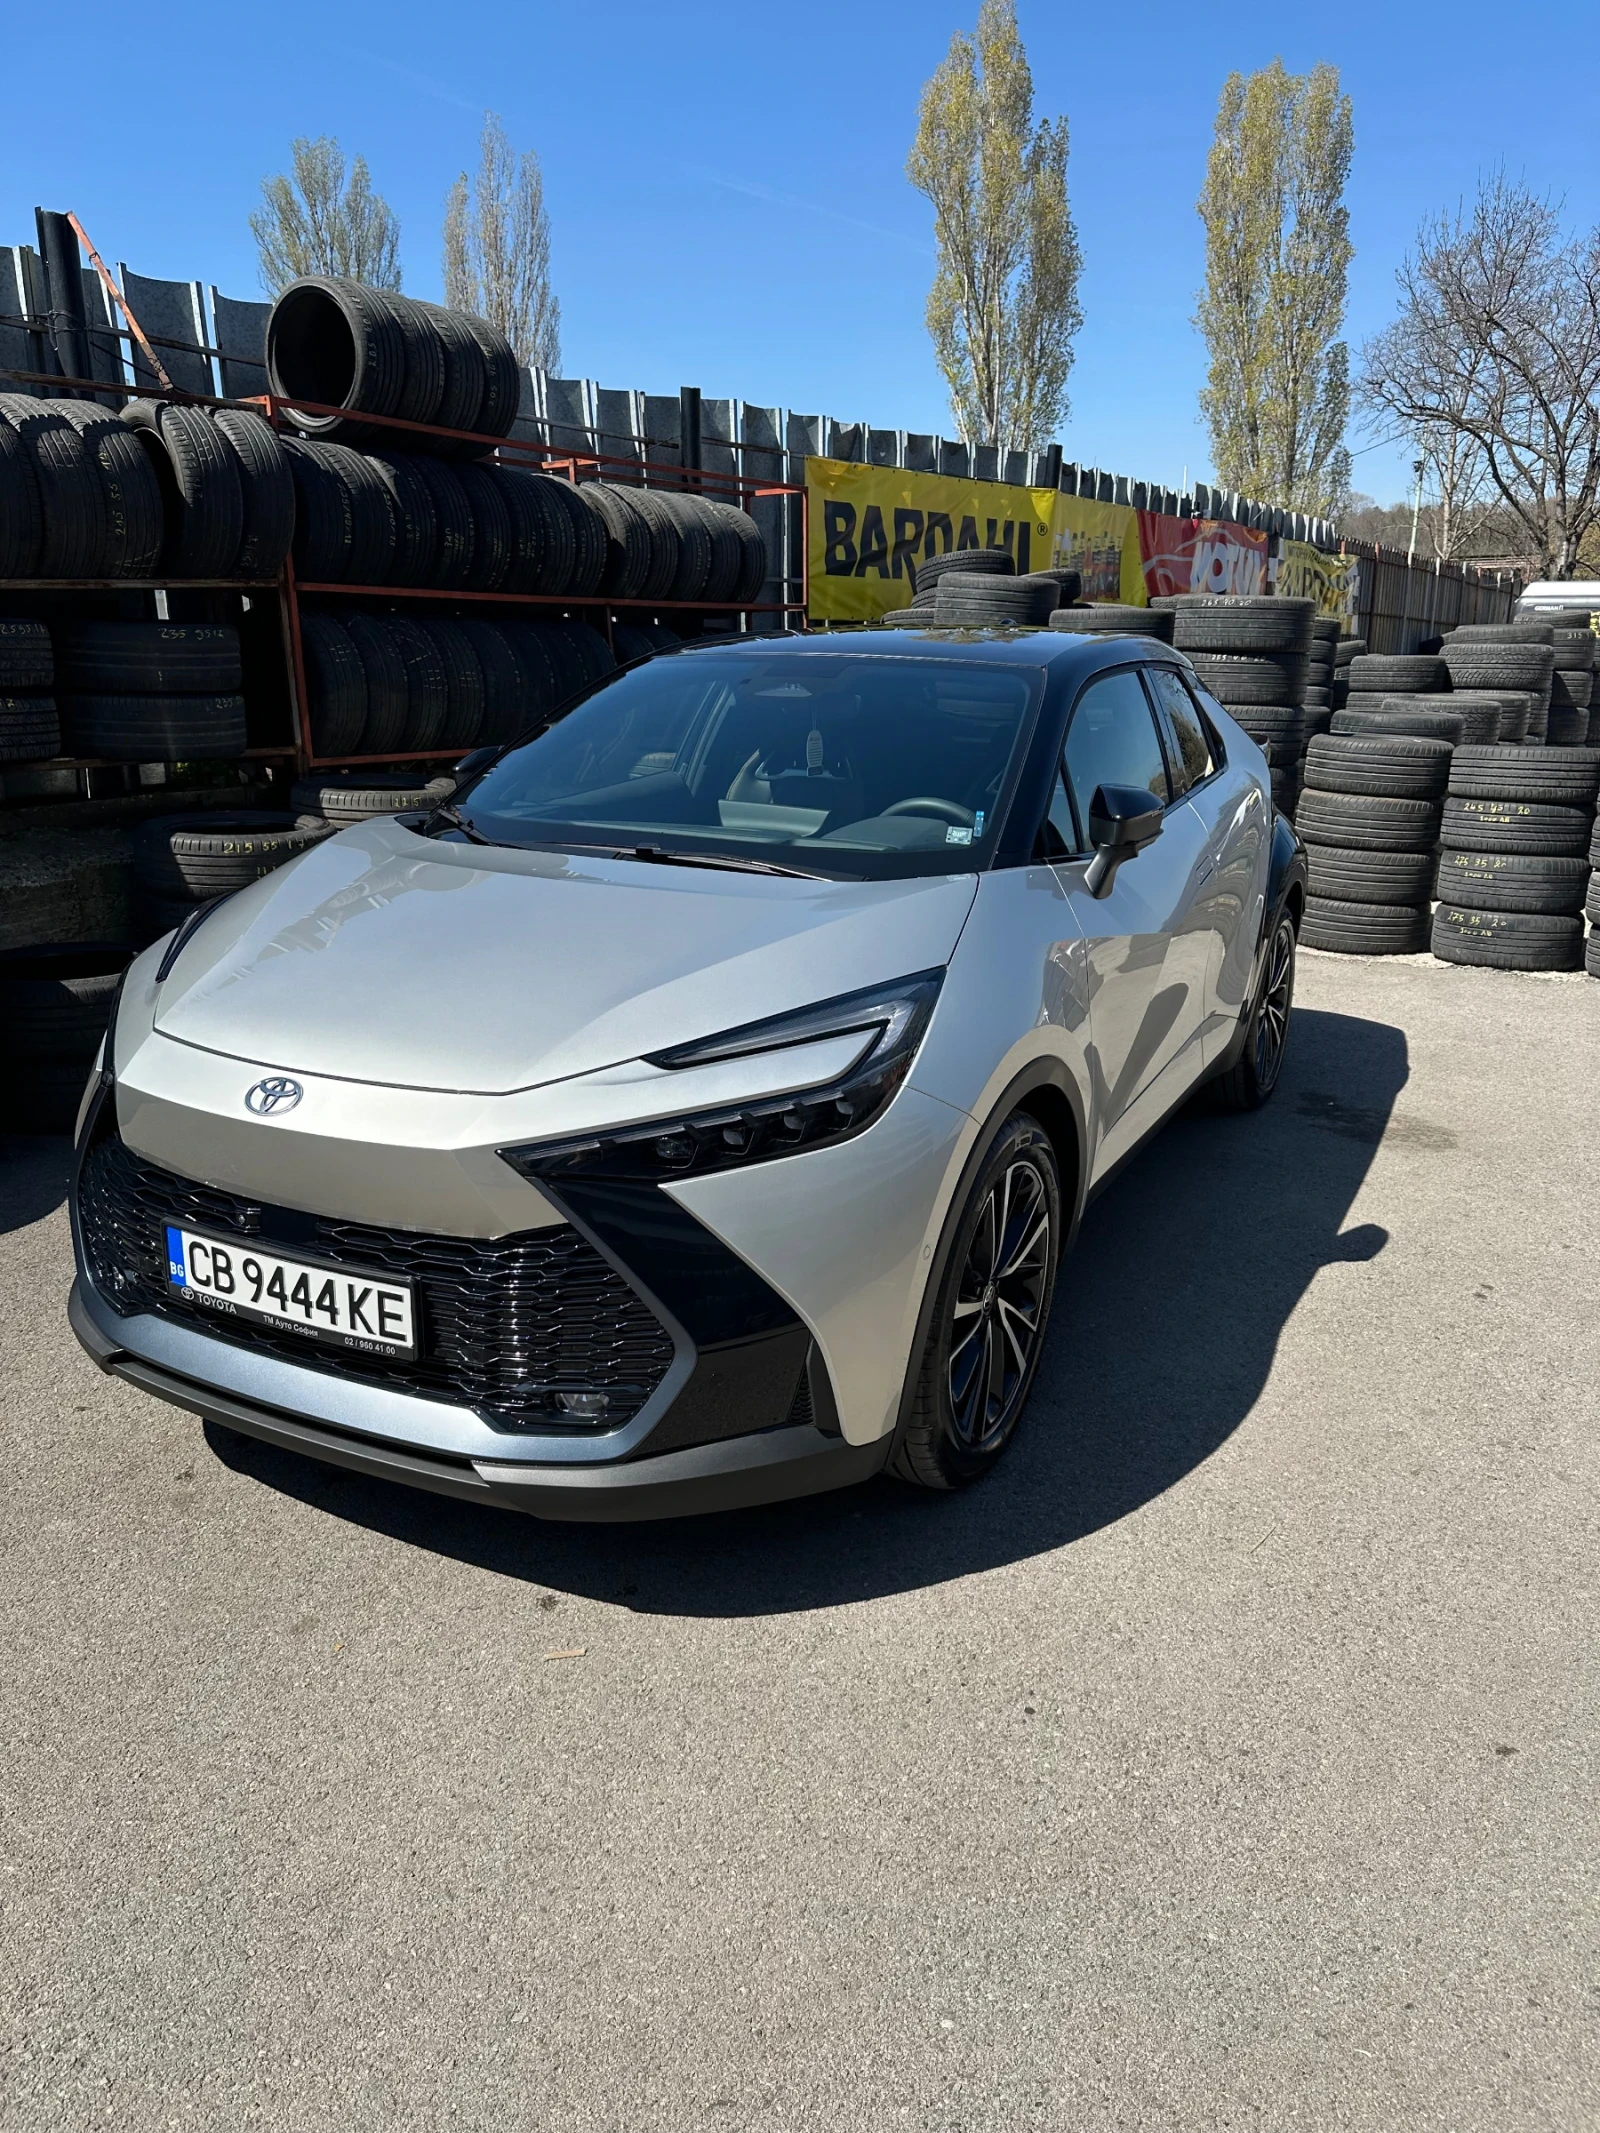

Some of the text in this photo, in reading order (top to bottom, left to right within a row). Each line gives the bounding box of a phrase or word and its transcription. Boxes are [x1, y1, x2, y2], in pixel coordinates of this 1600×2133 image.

[1463, 802, 1484, 812] 245
[1517, 805, 1531, 815] 20
[223, 842, 254, 853] 215
[262, 841, 278, 851] 55
[1454, 855, 1469, 866] 275
[1474, 858, 1488, 868] 35
[1491, 918, 1507, 927] 20
[169, 1260, 185, 1278] BG
[188, 1240, 408, 1343] CB 9444 KE
[197, 1292, 237, 1315] TOYOTA
[275, 1317, 292, 1330] Ауто
[293, 1323, 319, 1338] София
[344, 1336, 353, 1346] 02
[375, 1343, 384, 1353] 41
[386, 1345, 396, 1355] 00
